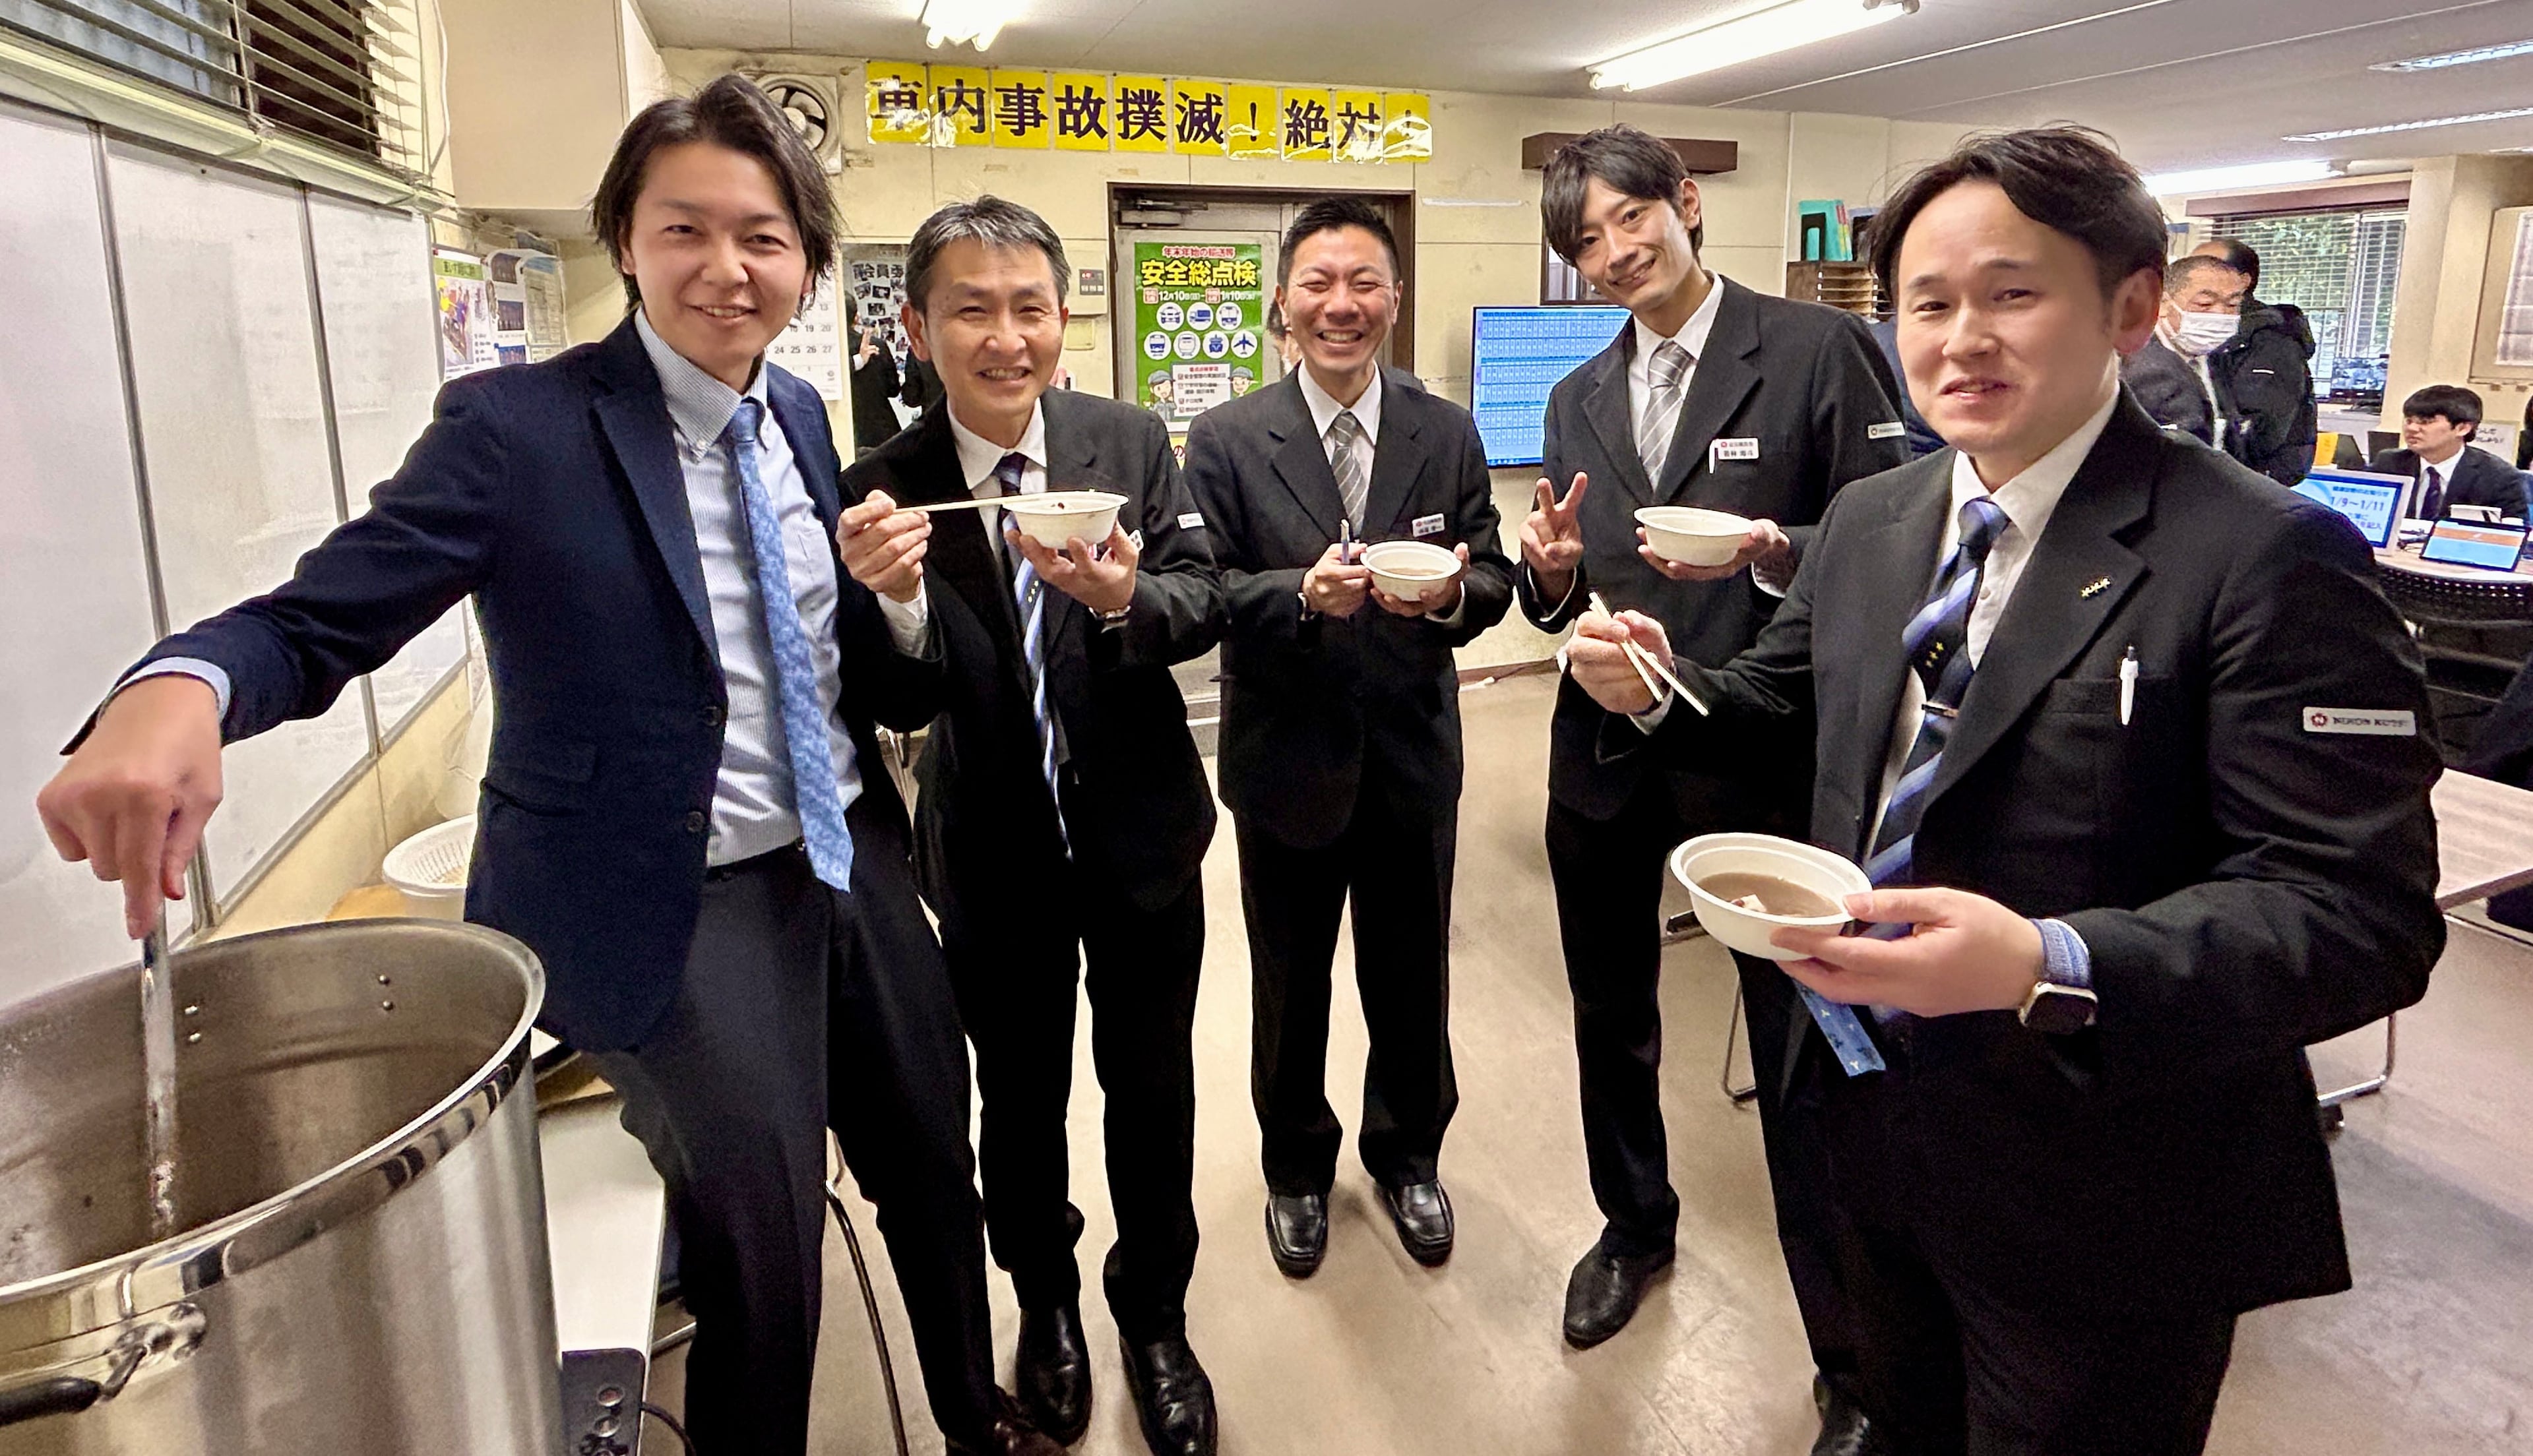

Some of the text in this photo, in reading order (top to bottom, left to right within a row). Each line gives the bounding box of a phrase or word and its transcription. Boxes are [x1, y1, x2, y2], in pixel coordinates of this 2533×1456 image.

[1141, 260, 1257, 286] 安全総点検
